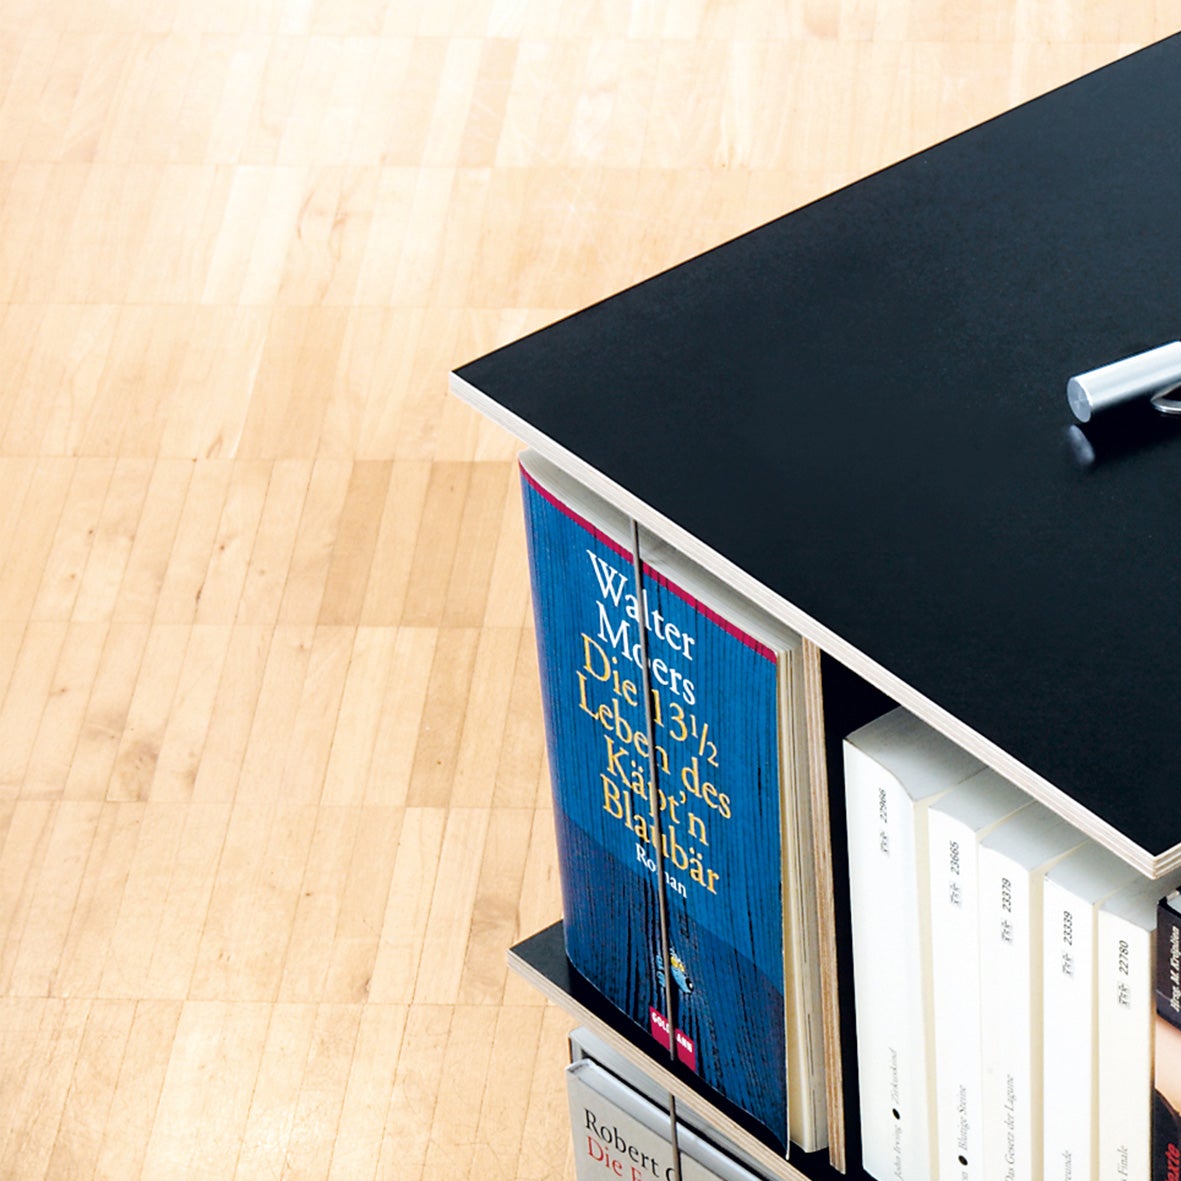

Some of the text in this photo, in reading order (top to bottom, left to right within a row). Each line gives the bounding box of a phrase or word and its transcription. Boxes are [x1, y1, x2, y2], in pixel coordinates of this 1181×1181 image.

[587, 549, 695, 660] Walter
[581, 633, 637, 707] Die
[597, 601, 695, 705] Moers
[576, 670, 732, 820] Leben des
[600, 773, 720, 895] Blaubär
[1119, 940, 1129, 976] 22780
[584, 1107, 660, 1179] Robert
[586, 1135, 623, 1177] Die
[1117, 1145, 1129, 1176] Finale
